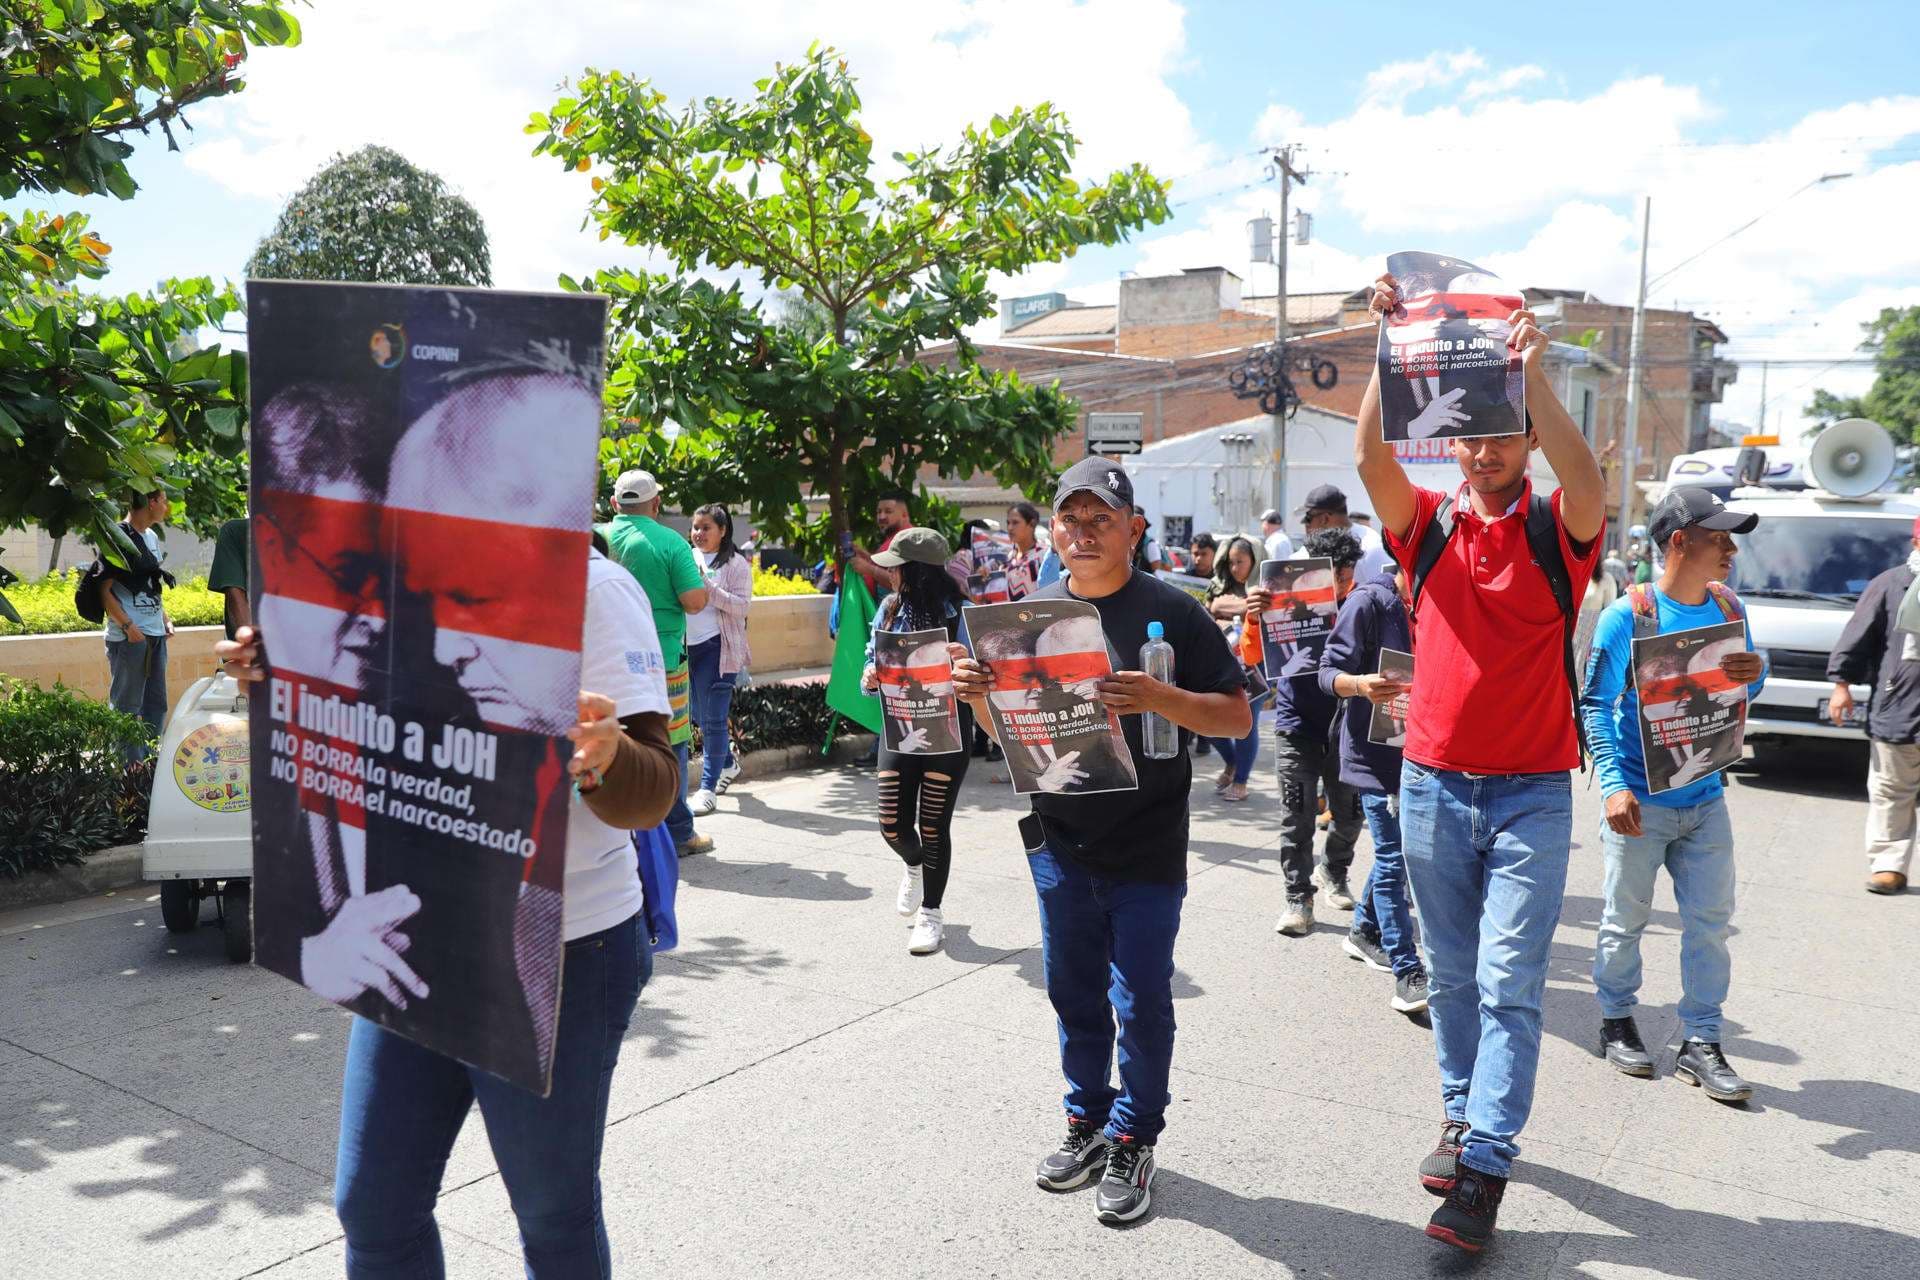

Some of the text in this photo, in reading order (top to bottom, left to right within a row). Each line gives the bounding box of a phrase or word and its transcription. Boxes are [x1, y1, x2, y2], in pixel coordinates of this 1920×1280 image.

[412, 344, 459, 362] COPINH
[1457, 340, 1464, 350] a
[1469, 338, 1494, 349] JOH
[1391, 357, 1404, 365] NO
[1391, 366, 1404, 374] NO
[1451, 357, 1511, 369] narcoestado
[918, 700, 924, 708] a
[925, 698, 940, 707] JOH
[1001, 702, 1095, 725] El indulto a JOH
[1650, 708, 1729, 733] El indulto a JOH
[270, 677, 497, 781] El indulto a JOH
[1060, 723, 1112, 737] narcoestado
[271, 730, 298, 756] NO
[391, 771, 475, 816] verdad,
[271, 756, 298, 783] NO
[388, 799, 537, 858] narcoestado
